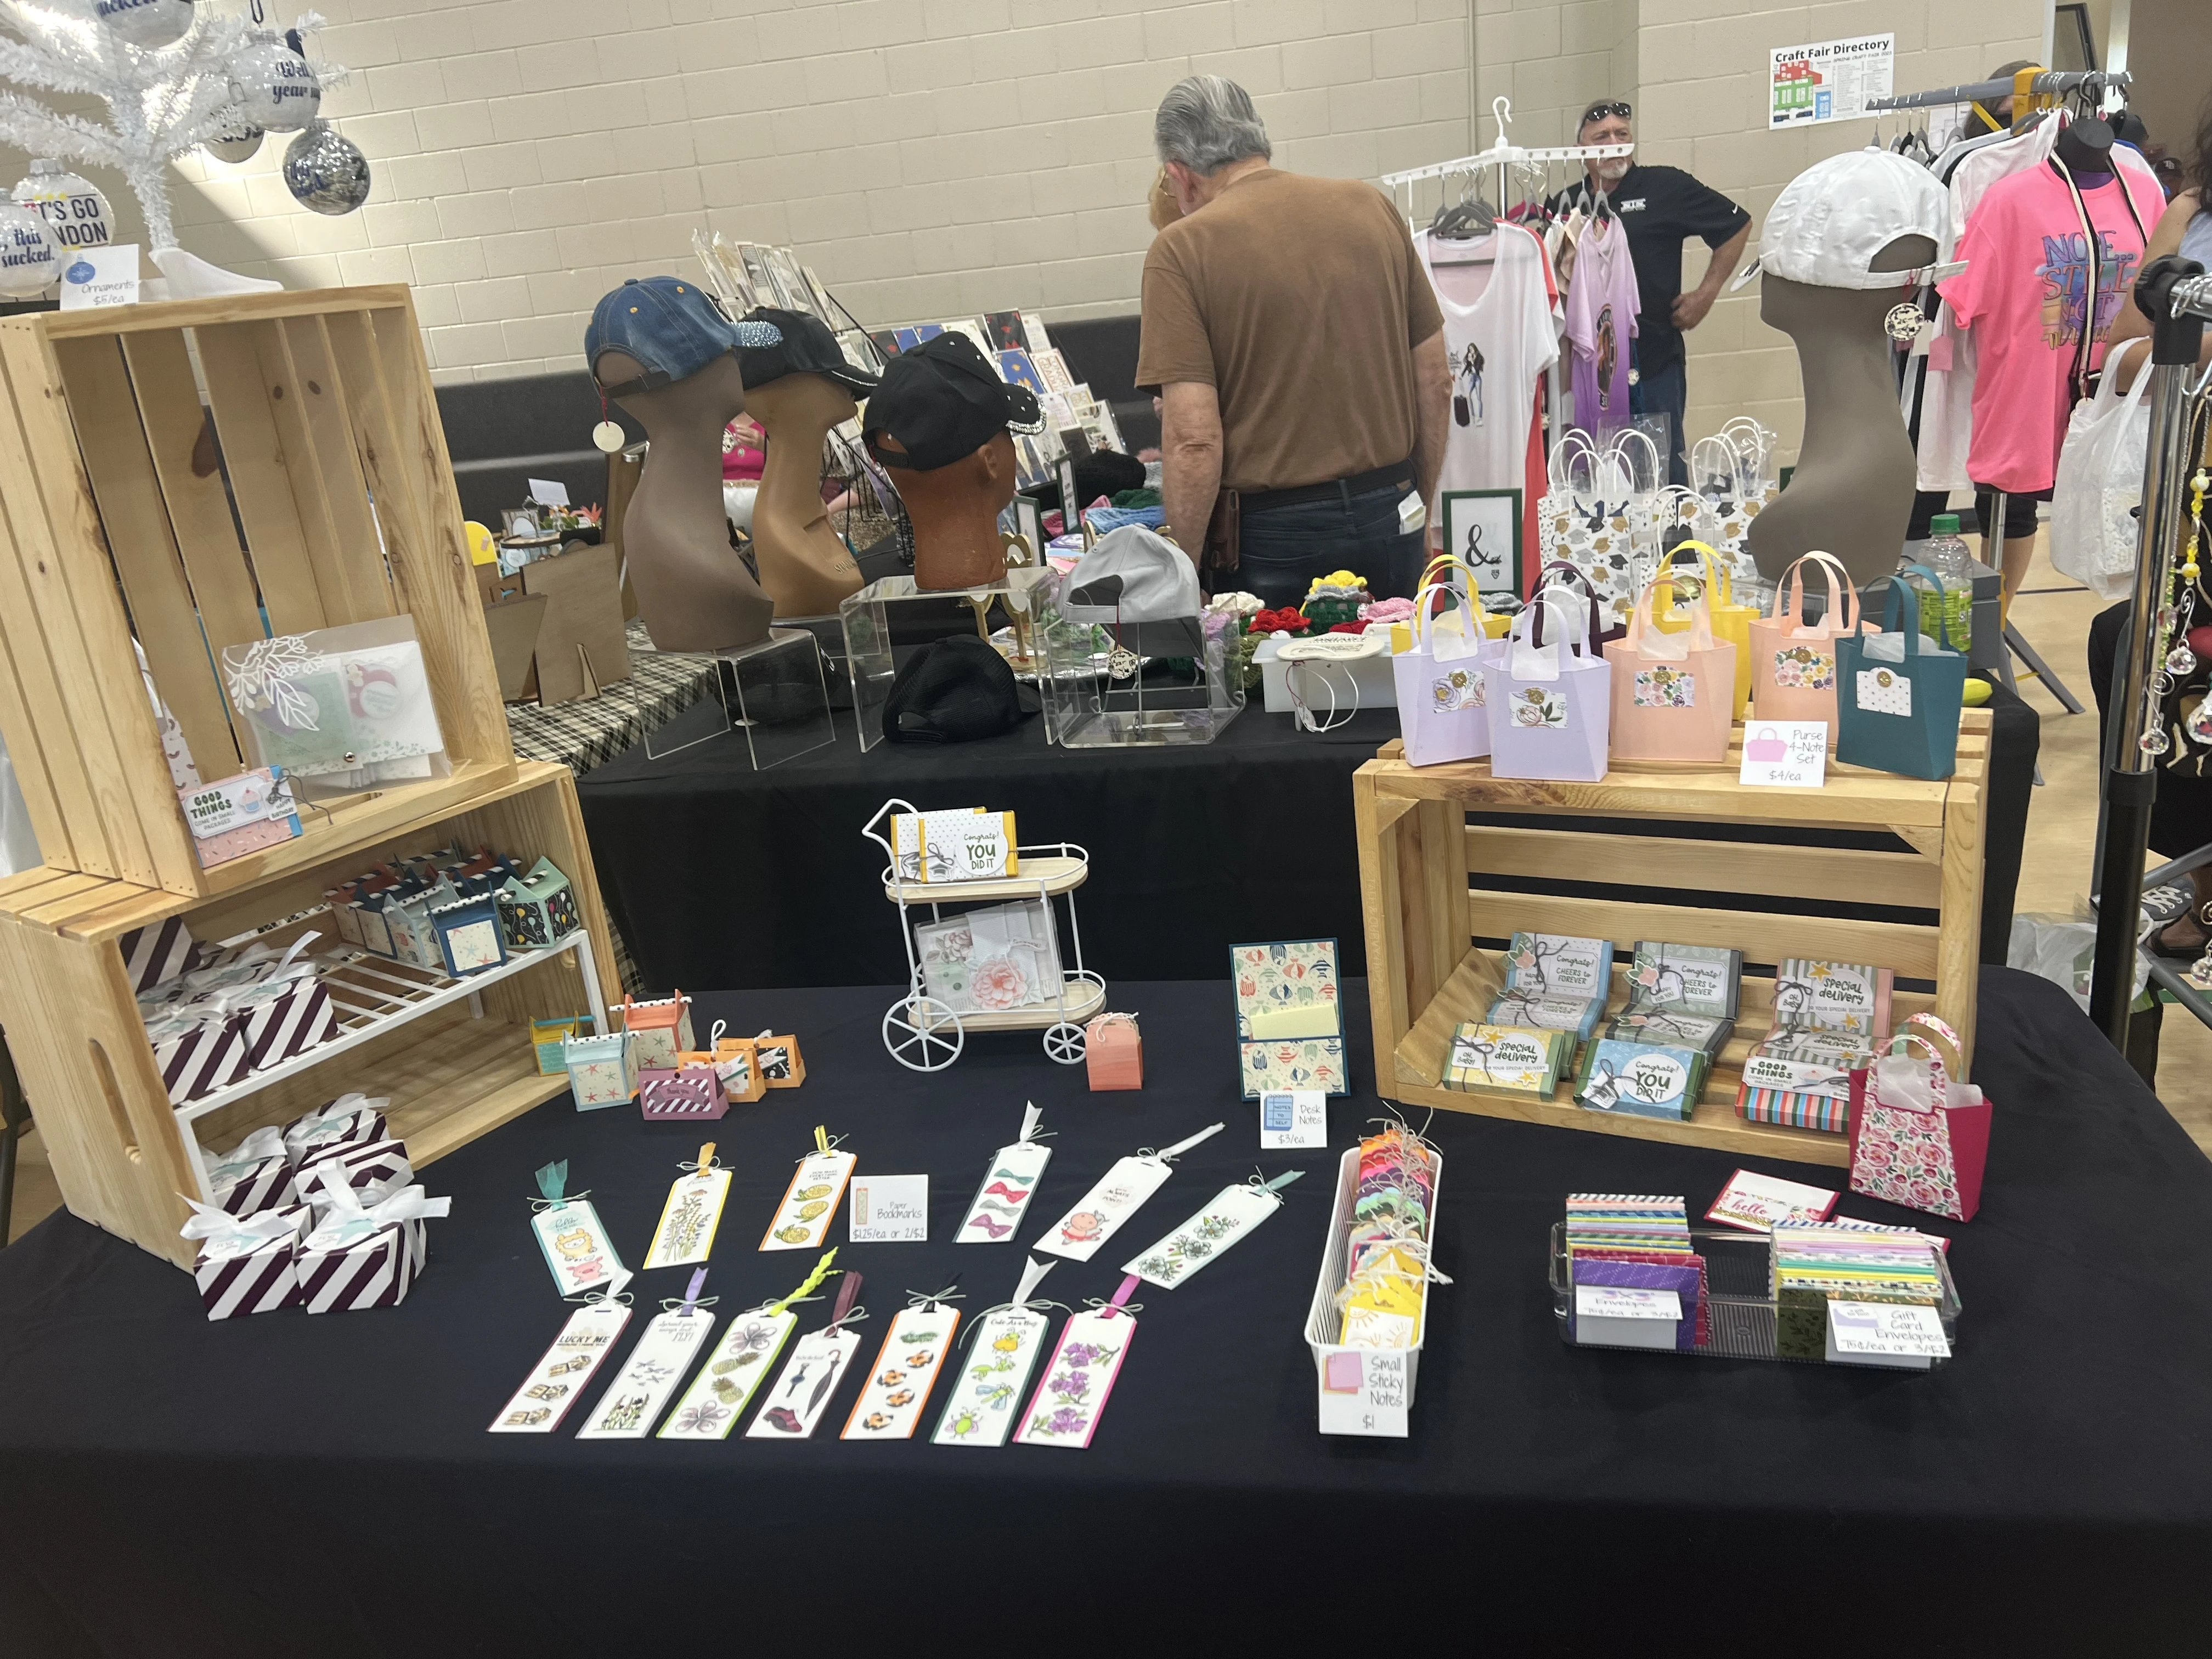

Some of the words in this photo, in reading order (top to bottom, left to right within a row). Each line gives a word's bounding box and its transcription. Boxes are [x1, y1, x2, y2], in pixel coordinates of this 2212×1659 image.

[1775, 50, 1805, 63] Craft
[1808, 46, 1830, 59] Fair
[1833, 40, 1889, 54] Directory
[273, 85, 308, 104] year
[71, 198, 99, 219] GO
[14, 228, 42, 246] this
[2042, 230, 2134, 267] NOE...
[1, 244, 55, 268] sucked.
[82, 280, 134, 294] Ornaments
[1793, 730, 1823, 740] Purse
[1789, 742, 1825, 753] 4-Note
[1797, 754, 1816, 764] Set
[1769, 770, 1802, 781] $4/ea
[194, 791, 222, 806] GOOD
[276, 798, 291, 809] HAPPY
[190, 799, 232, 819] THINGS
[271, 807, 294, 819] BIRTHDAY
[195, 818, 210, 827] COME
[218, 810, 236, 819] SMALL
[204, 818, 232, 830] PACKAGES
[964, 831, 999, 843] Congrats!
[966, 844, 996, 860] YOU
[972, 860, 985, 870] DID
[986, 858, 994, 868] IT
[1556, 955, 1594, 967] Congrats!
[1556, 968, 1582, 977] CHEERS
[1681, 965, 1722, 979] Congrats!
[1558, 975, 1587, 985] FOREVER
[1636, 1061, 1679, 1073] Congrats!
[1758, 1061, 1787, 1070] GOOD
[1750, 1067, 1793, 1079] THINGS
[1636, 1070, 1671, 1089] YOU
[1655, 1088, 1666, 1099] IT
[1300, 1104, 1322, 1114] Desk
[1299, 1115, 1322, 1125] Notes
[1278, 1134, 1305, 1144] $3/ea
[890, 1201, 907, 1210] Paper
[1731, 1199, 1768, 1215] hello
[878, 1208, 922, 1219] Bookmarks
[890, 1231, 900, 1239] or
[905, 1227, 925, 1239] 2/$2
[1596, 1298, 1657, 1308] Envelopes
[1891, 1310, 1917, 1321] Gift
[1891, 1320, 1922, 1331] Card
[1875, 1328, 1944, 1344] Envelopes
[1914, 1344, 1946, 1355] 3/$2
[1371, 1356, 1401, 1372] Small
[1369, 1373, 1403, 1394] Sticky
[1370, 1390, 1403, 1407] Notes
[1362, 1413, 1375, 1430] $1
